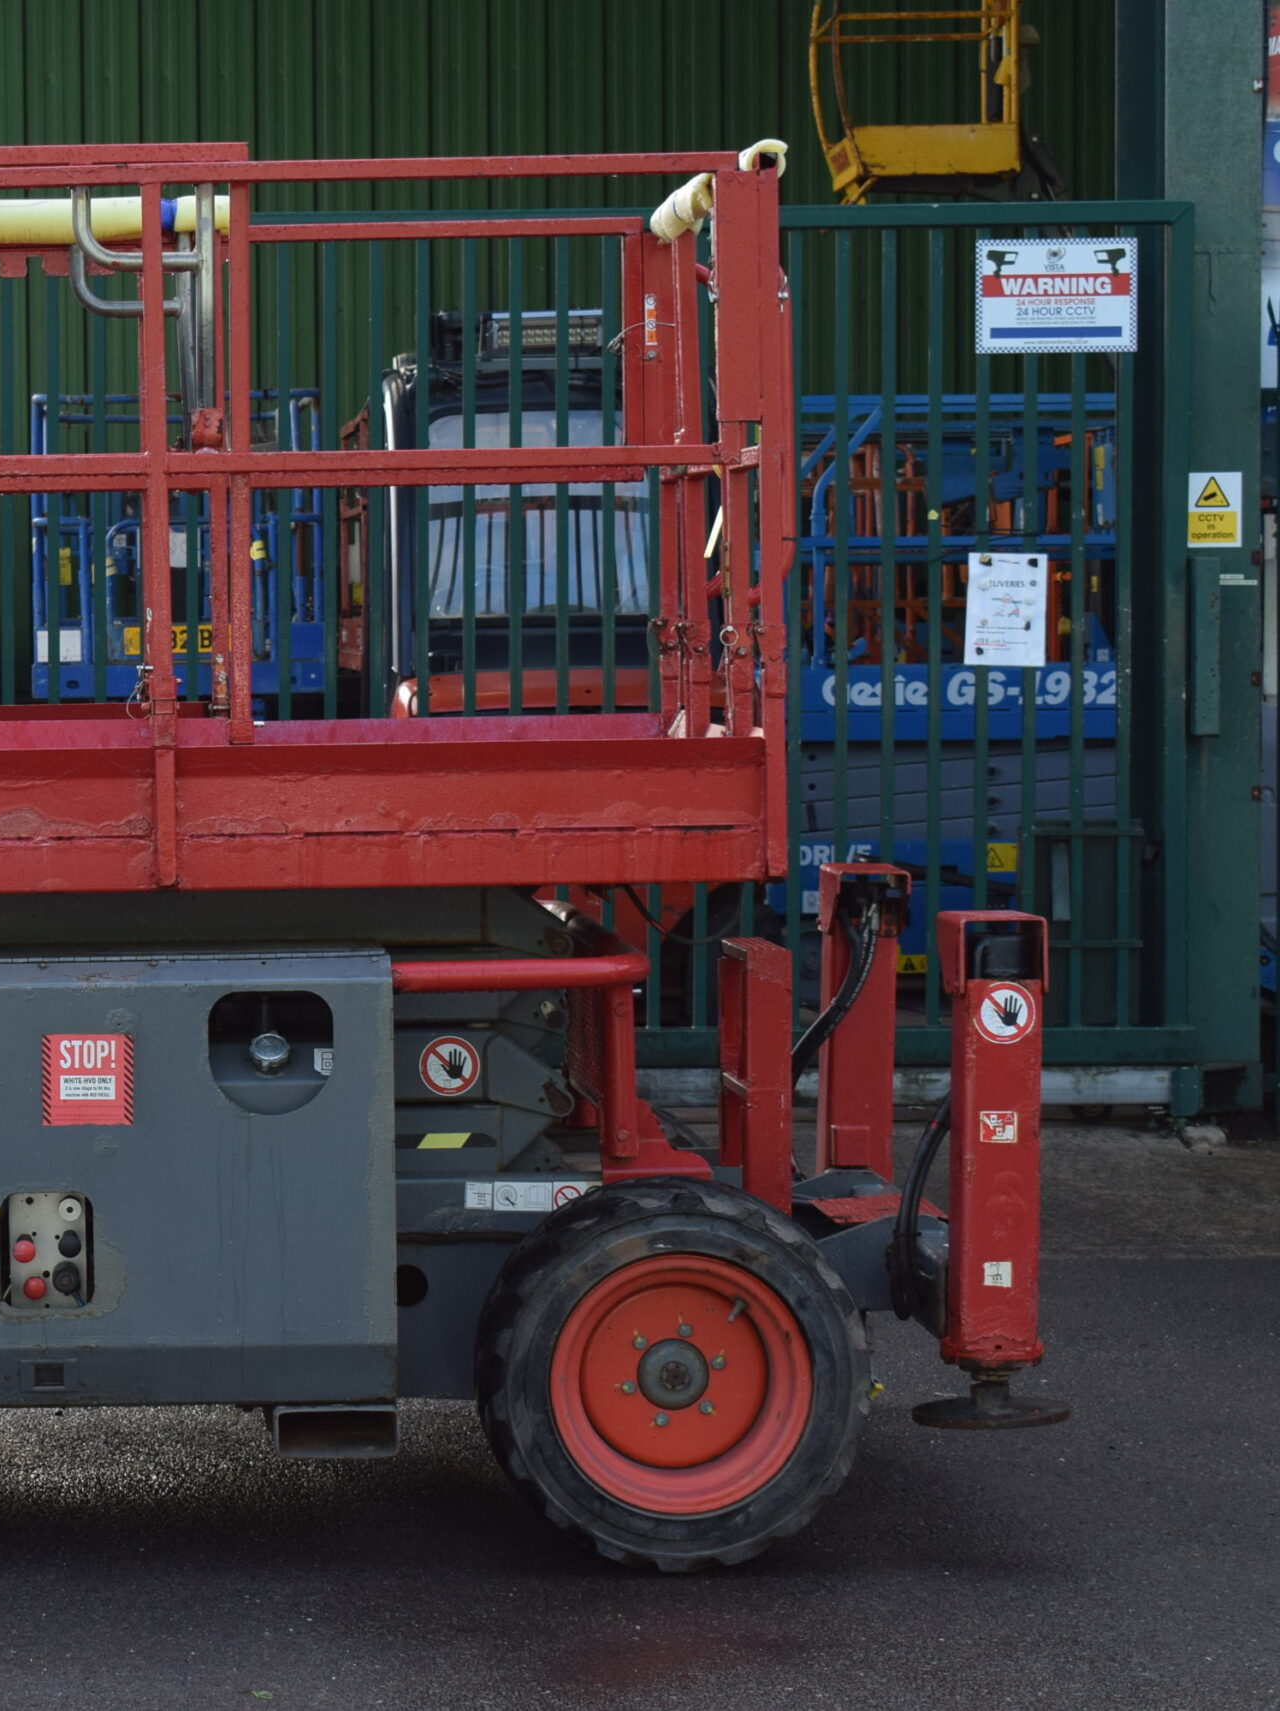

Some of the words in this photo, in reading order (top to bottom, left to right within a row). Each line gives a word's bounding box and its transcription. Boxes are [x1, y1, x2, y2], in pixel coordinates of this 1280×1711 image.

[1001, 277, 1111, 295] WARNING
[1027, 298, 1051, 306] HOUR
[1055, 298, 1095, 306] RESPONSE
[1016, 307, 1029, 316] 24
[1032, 307, 1062, 316] HOUR
[1065, 306, 1095, 315] CCTV
[1198, 514, 1224, 522] CCTV
[1191, 532, 1234, 540] operation
[988, 580, 1026, 588] ELIVERIES
[60, 1040, 116, 1069] STOP!
